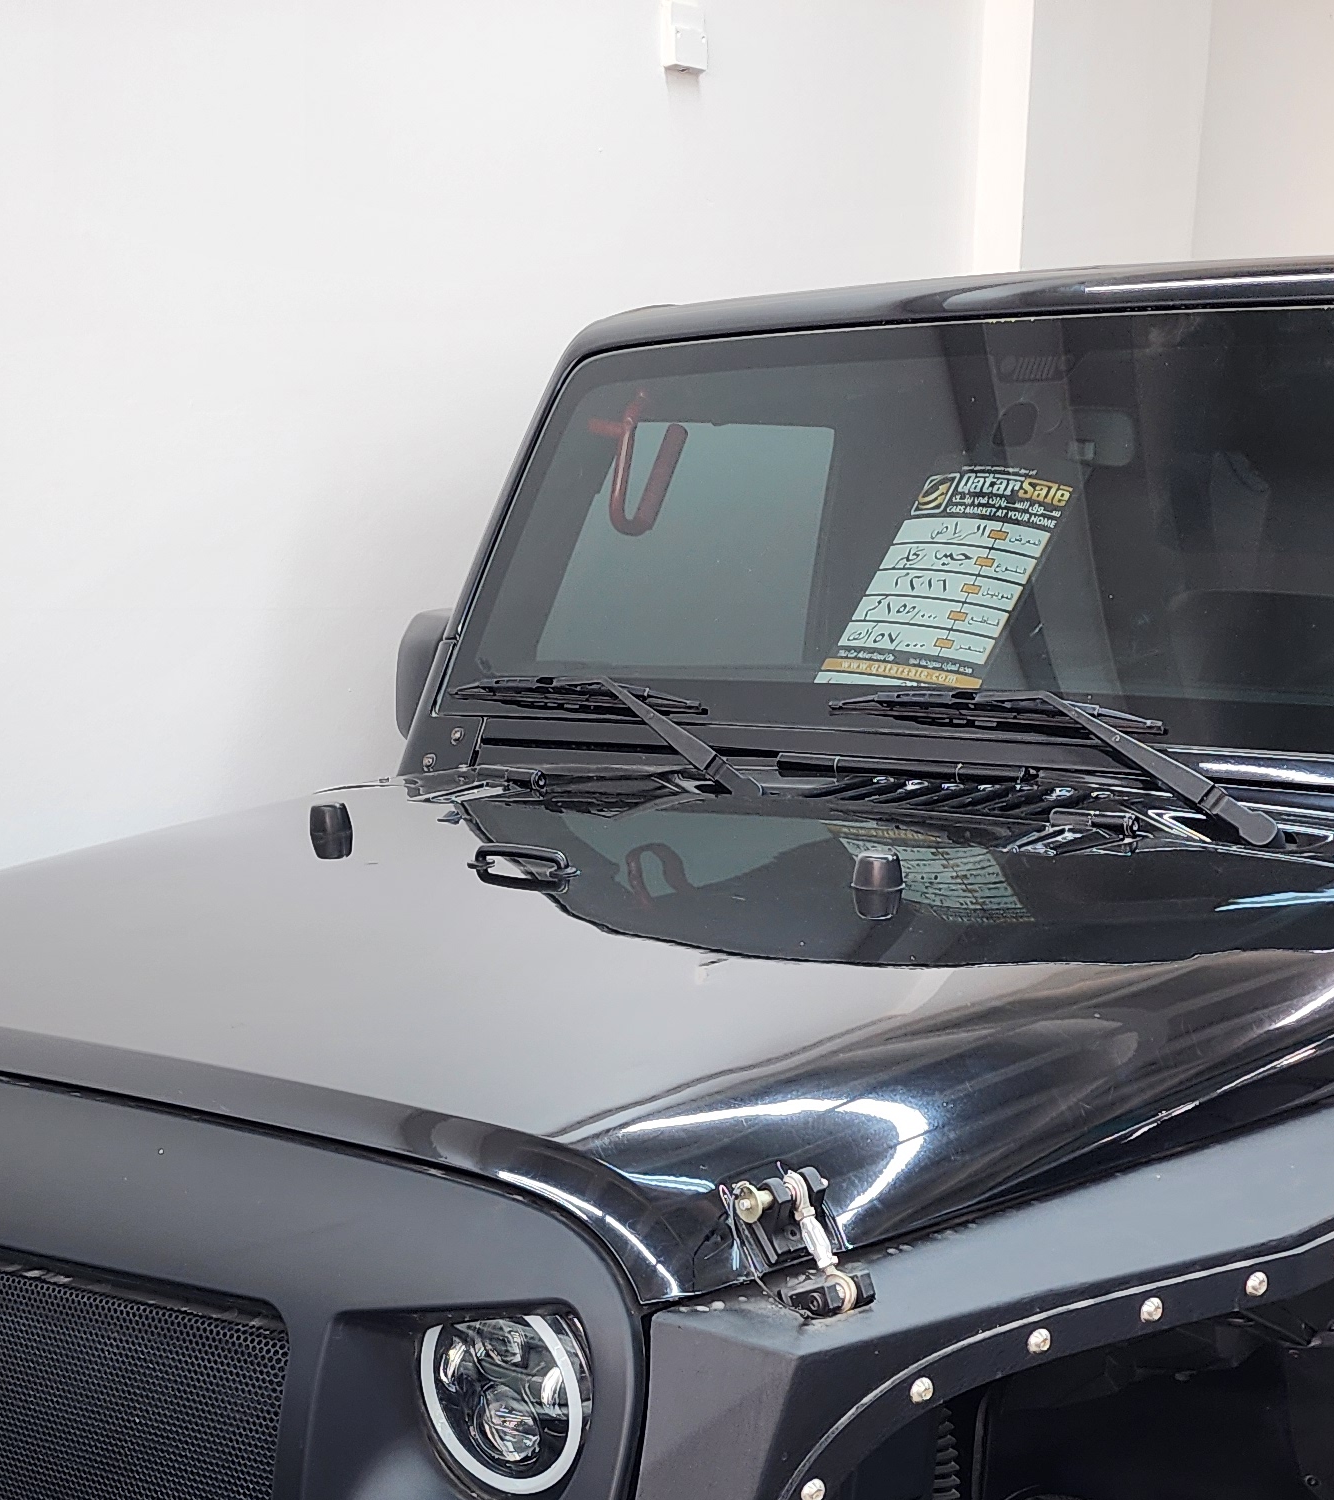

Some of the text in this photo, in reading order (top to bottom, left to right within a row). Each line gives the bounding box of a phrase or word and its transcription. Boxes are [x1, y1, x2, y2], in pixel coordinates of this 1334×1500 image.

[957, 472, 1074, 507] QatarSale
[947, 505, 965, 514] CARS
[965, 506, 996, 516] MARKET
[1008, 510, 1030, 522] YOUR
[1029, 514, 1057, 529] HOME
[841, 660, 957, 684] www.qatarsale.com
